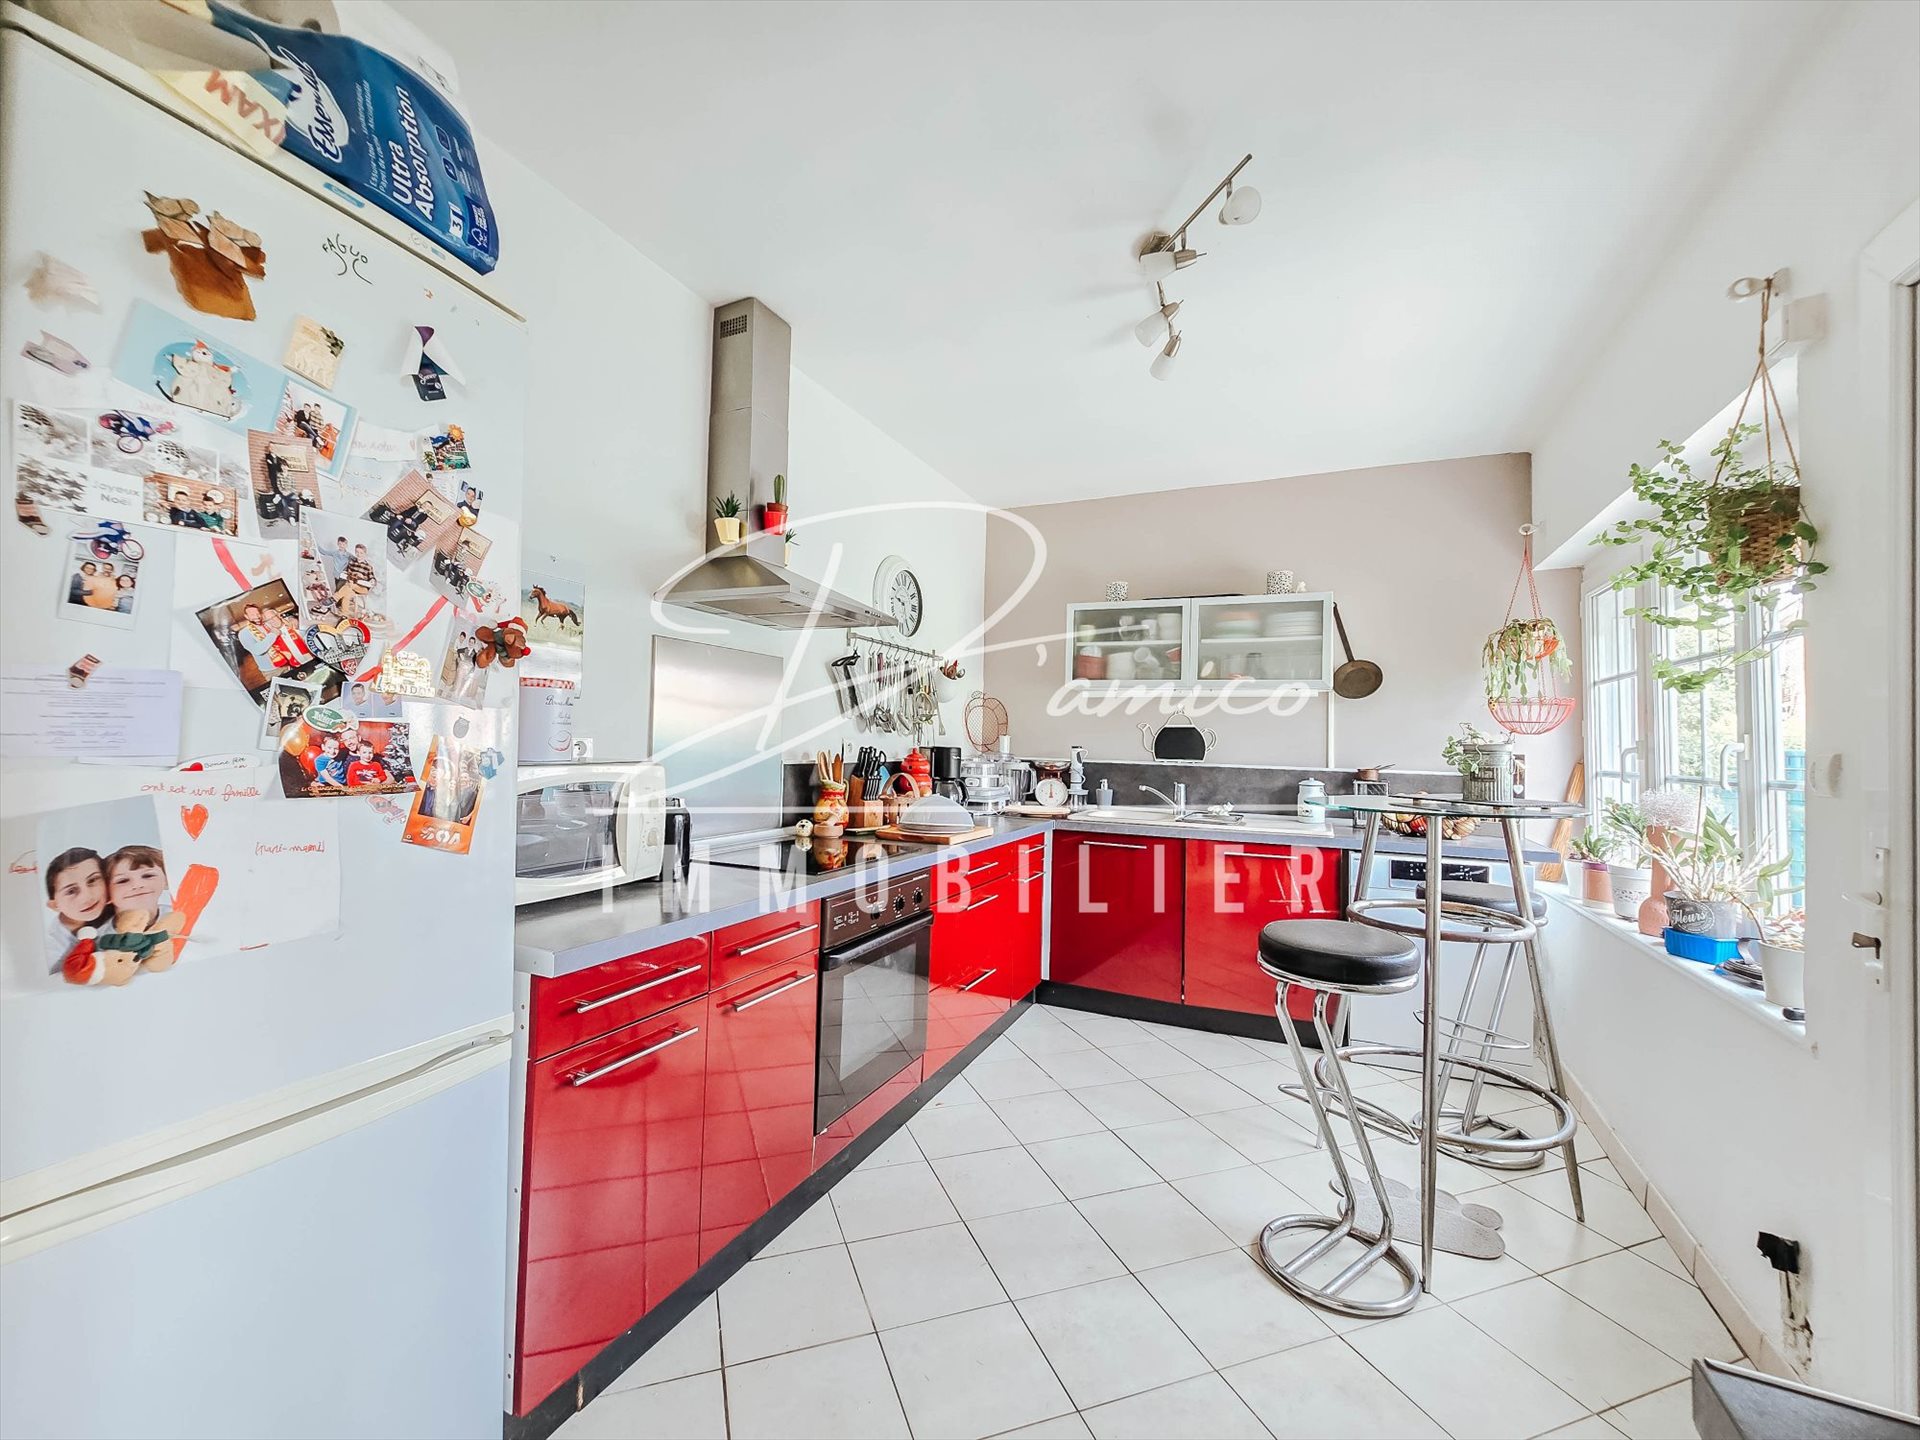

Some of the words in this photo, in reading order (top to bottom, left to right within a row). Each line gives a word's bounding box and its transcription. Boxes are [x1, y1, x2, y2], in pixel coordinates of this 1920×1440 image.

[388, 140, 412, 205] Ultra
[395, 86, 434, 221] Absorption
[1671, 908, 1707, 926] Fleurs
